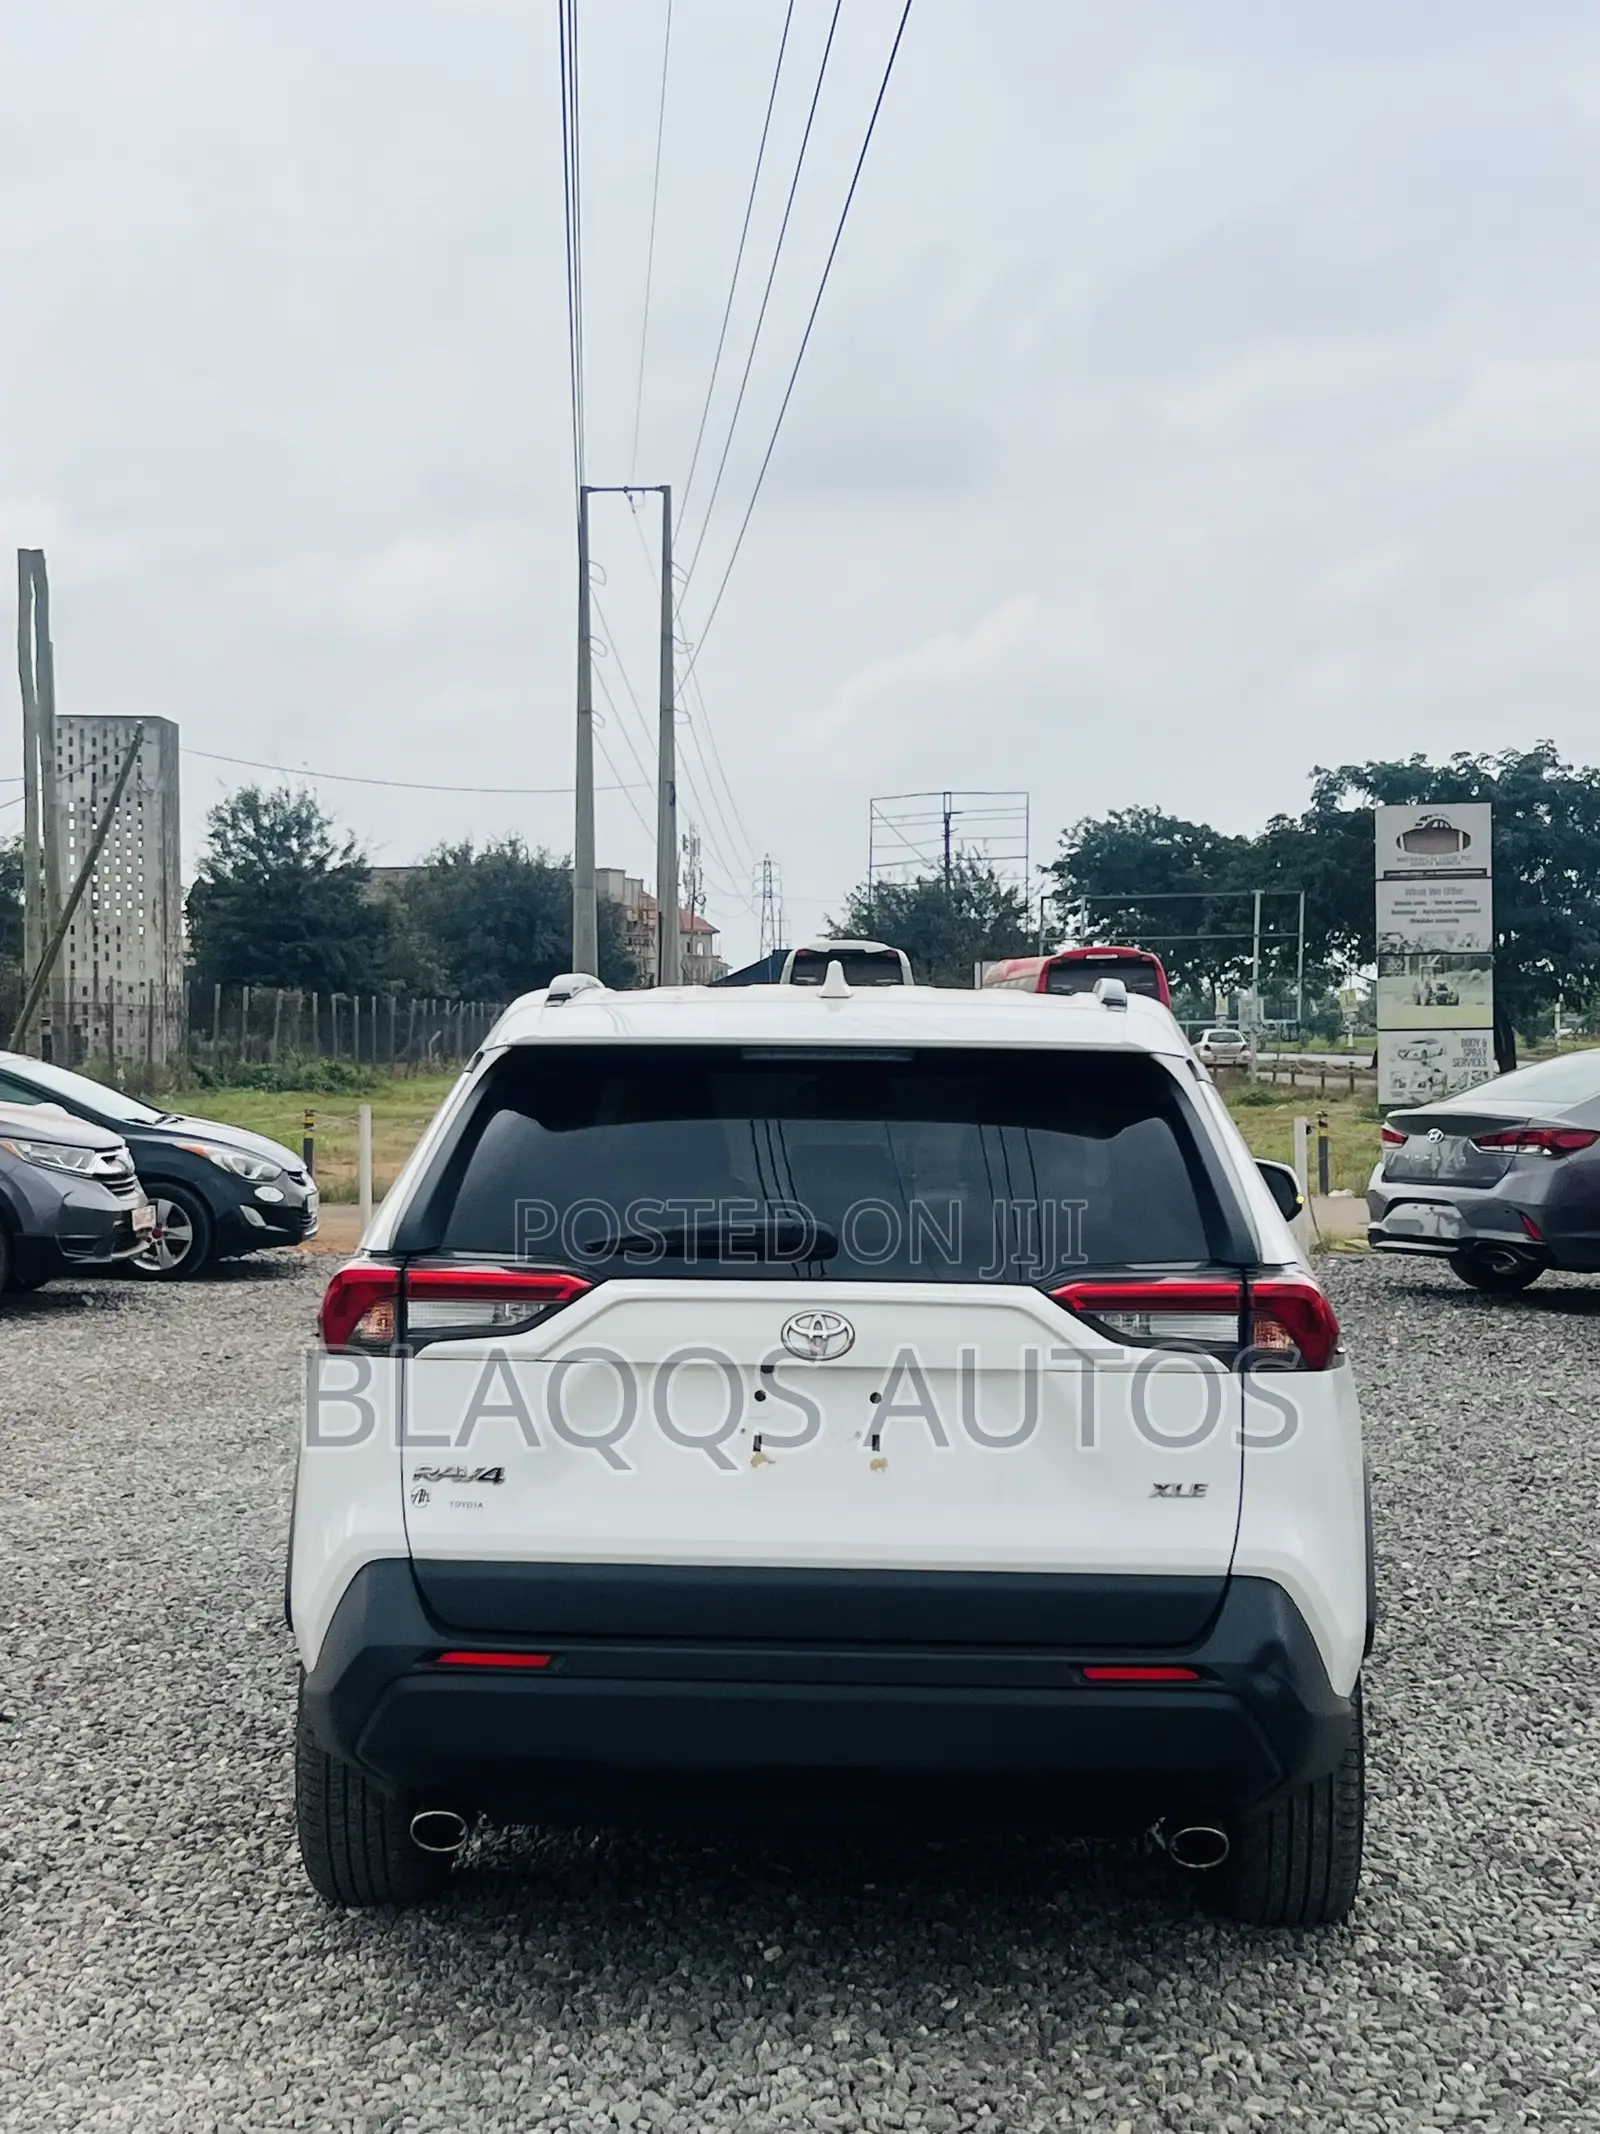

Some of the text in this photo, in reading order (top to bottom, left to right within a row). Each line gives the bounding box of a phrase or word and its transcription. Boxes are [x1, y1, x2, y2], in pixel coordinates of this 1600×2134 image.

[1461, 1038, 1480, 1047] BODY
[1463, 1048, 1487, 1057] SPRAY
[1452, 1058, 1487, 1067] SERVICES
[412, 1466, 506, 1485] RAV4
[1148, 1482, 1208, 1499] XLE
[450, 1500, 484, 1509] TOYOTA
